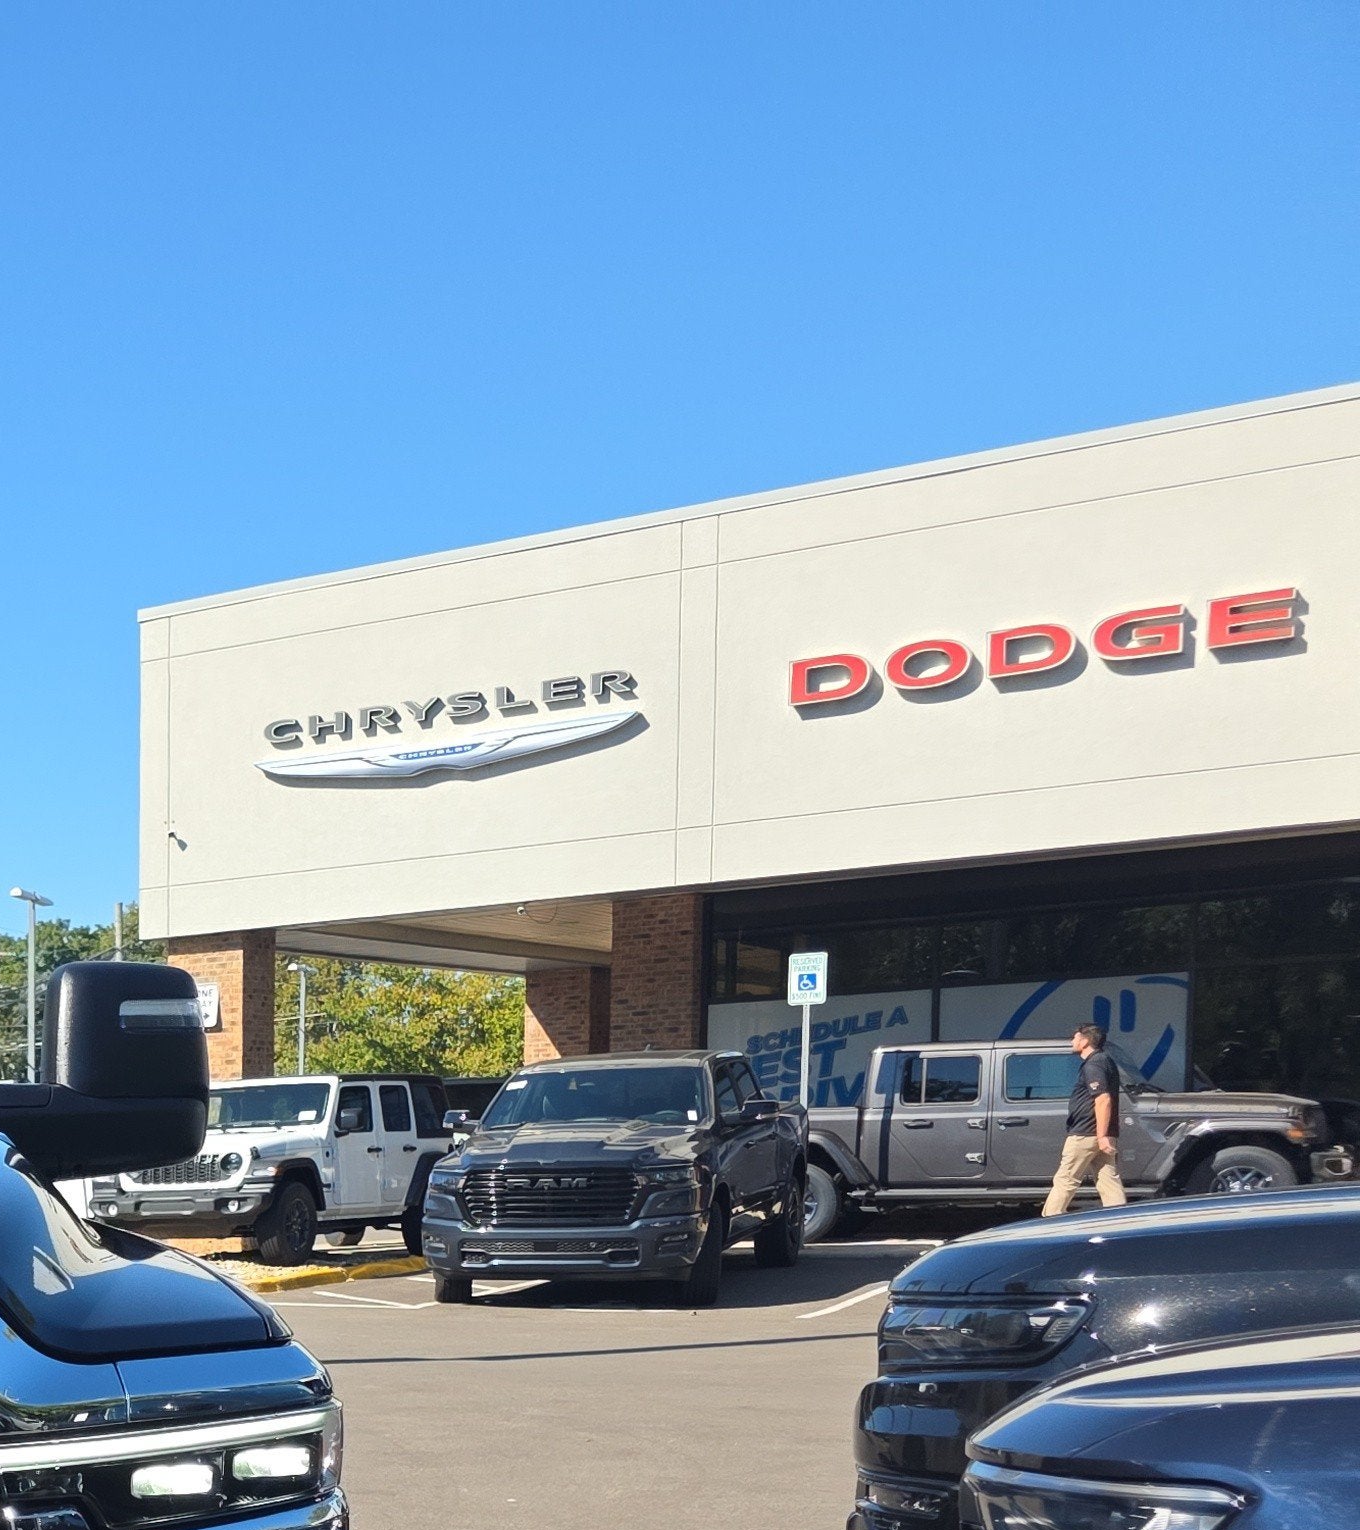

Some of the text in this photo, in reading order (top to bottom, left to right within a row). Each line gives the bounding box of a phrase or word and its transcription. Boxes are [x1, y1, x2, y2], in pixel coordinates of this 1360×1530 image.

[788, 586, 1297, 707] DODGE
[263, 669, 635, 746] CHRYSLER
[746, 1005, 909, 1054] SCHDULE A
[748, 1037, 847, 1089] EST
[505, 1177, 588, 1189] RAM
